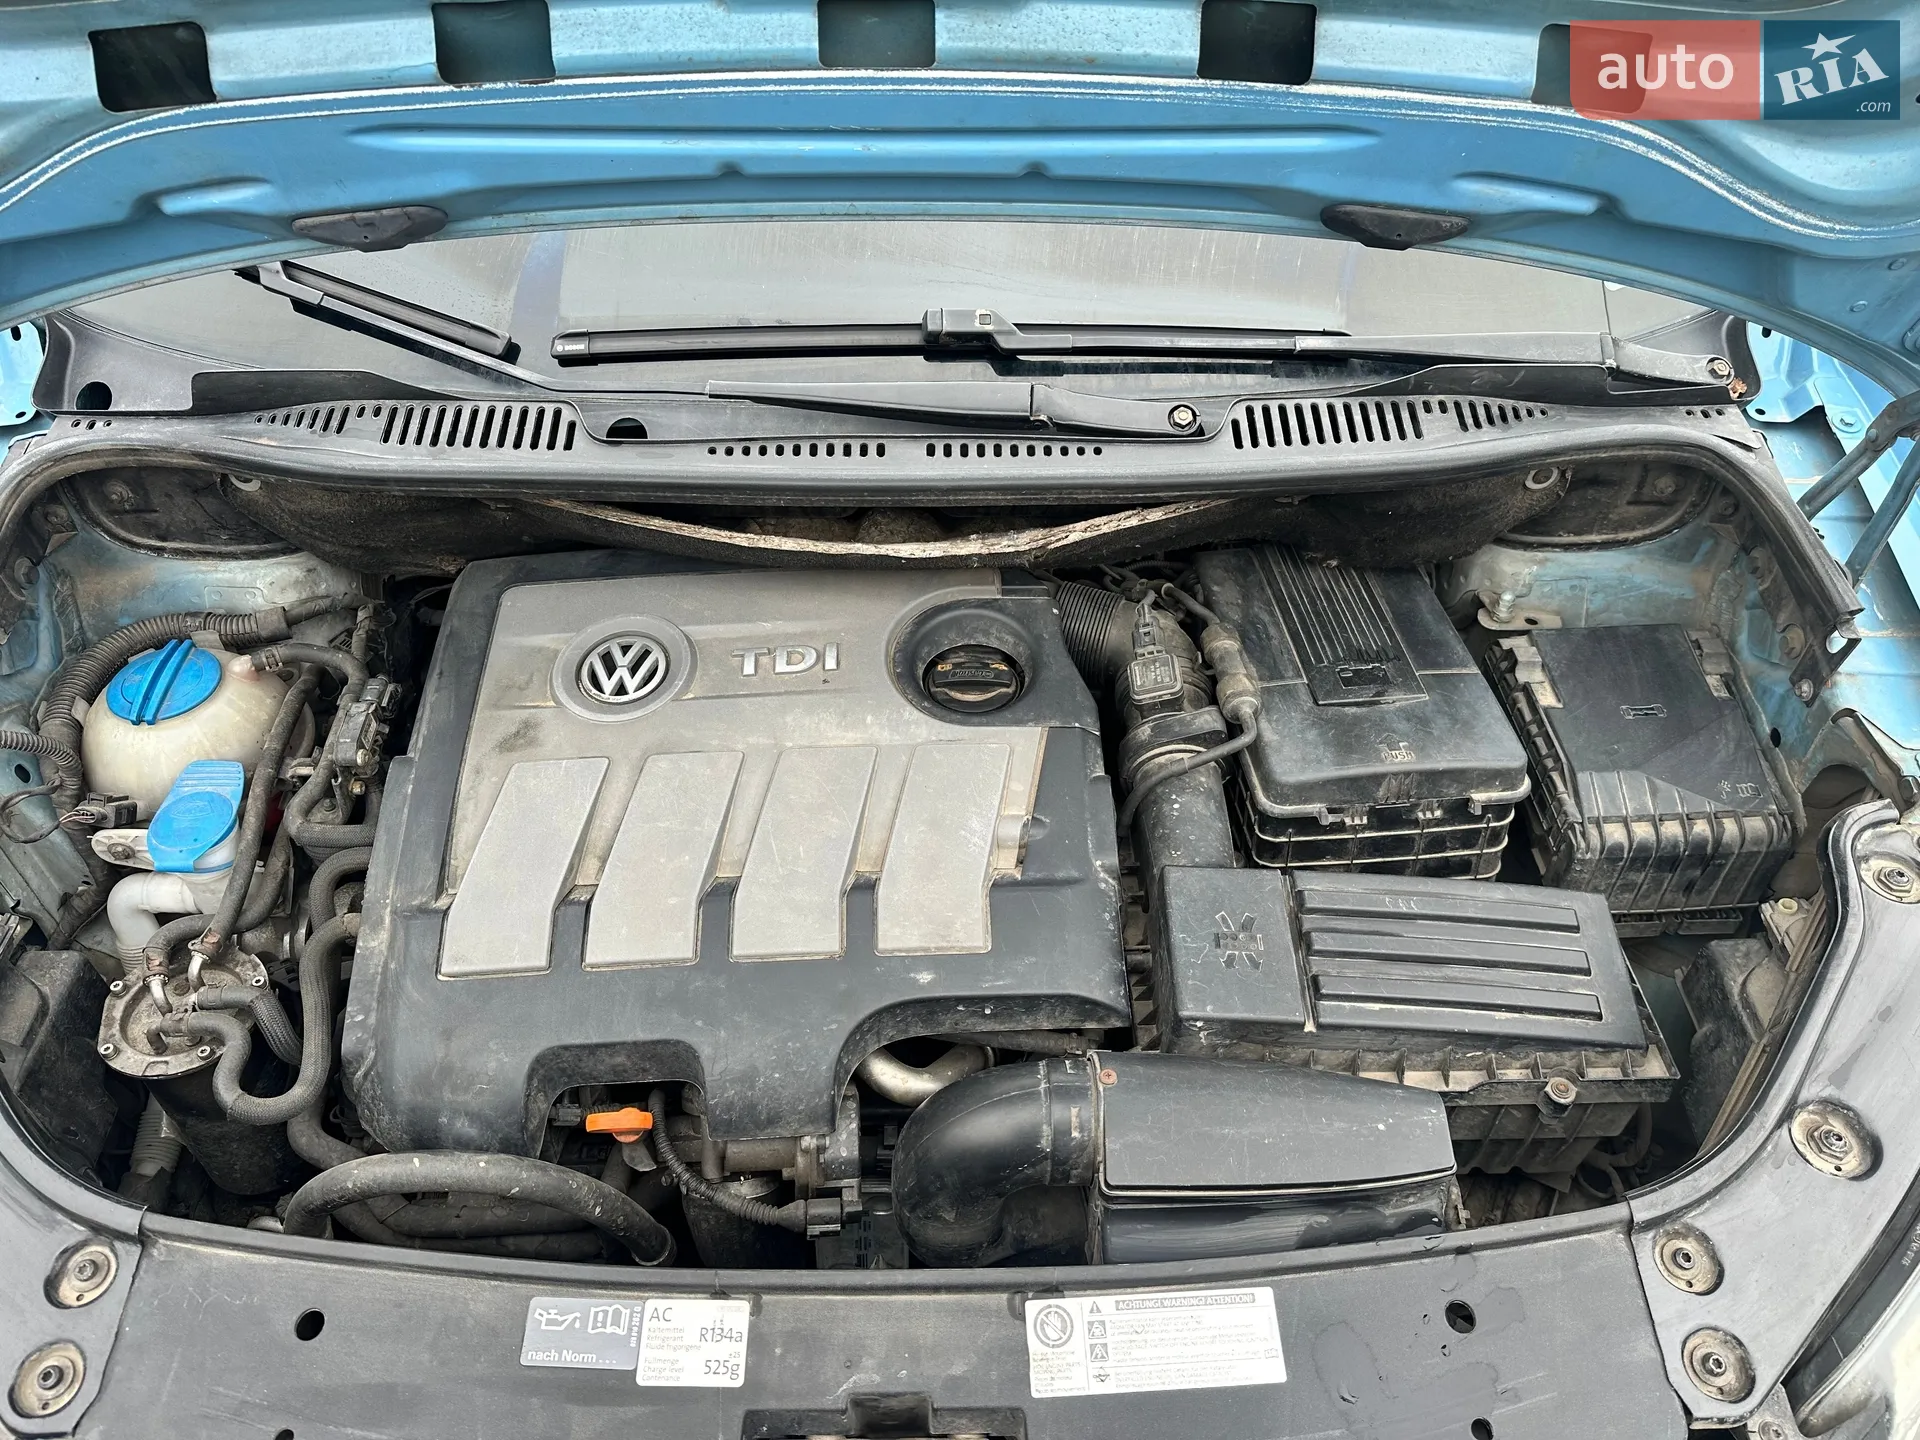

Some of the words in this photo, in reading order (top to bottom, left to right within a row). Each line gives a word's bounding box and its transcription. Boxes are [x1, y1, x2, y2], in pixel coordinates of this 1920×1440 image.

[733, 642, 841, 678] TDI
[1382, 750, 1415, 761] PUSH
[1118, 1299, 1160, 1310] ACHTUNG!
[1161, 1296, 1205, 1308] WARNING!
[1206, 1294, 1253, 1305] ATTENTION!
[648, 1307, 673, 1322] AC
[646, 1334, 684, 1343] Refrigerant
[699, 1327, 743, 1343] R134a
[645, 1342, 666, 1350] Fluide
[527, 1350, 559, 1362] nach
[561, 1350, 597, 1363] Norm
[642, 1366, 667, 1375] Charge
[703, 1359, 741, 1381] 525g
[641, 1374, 681, 1382] Contenance
